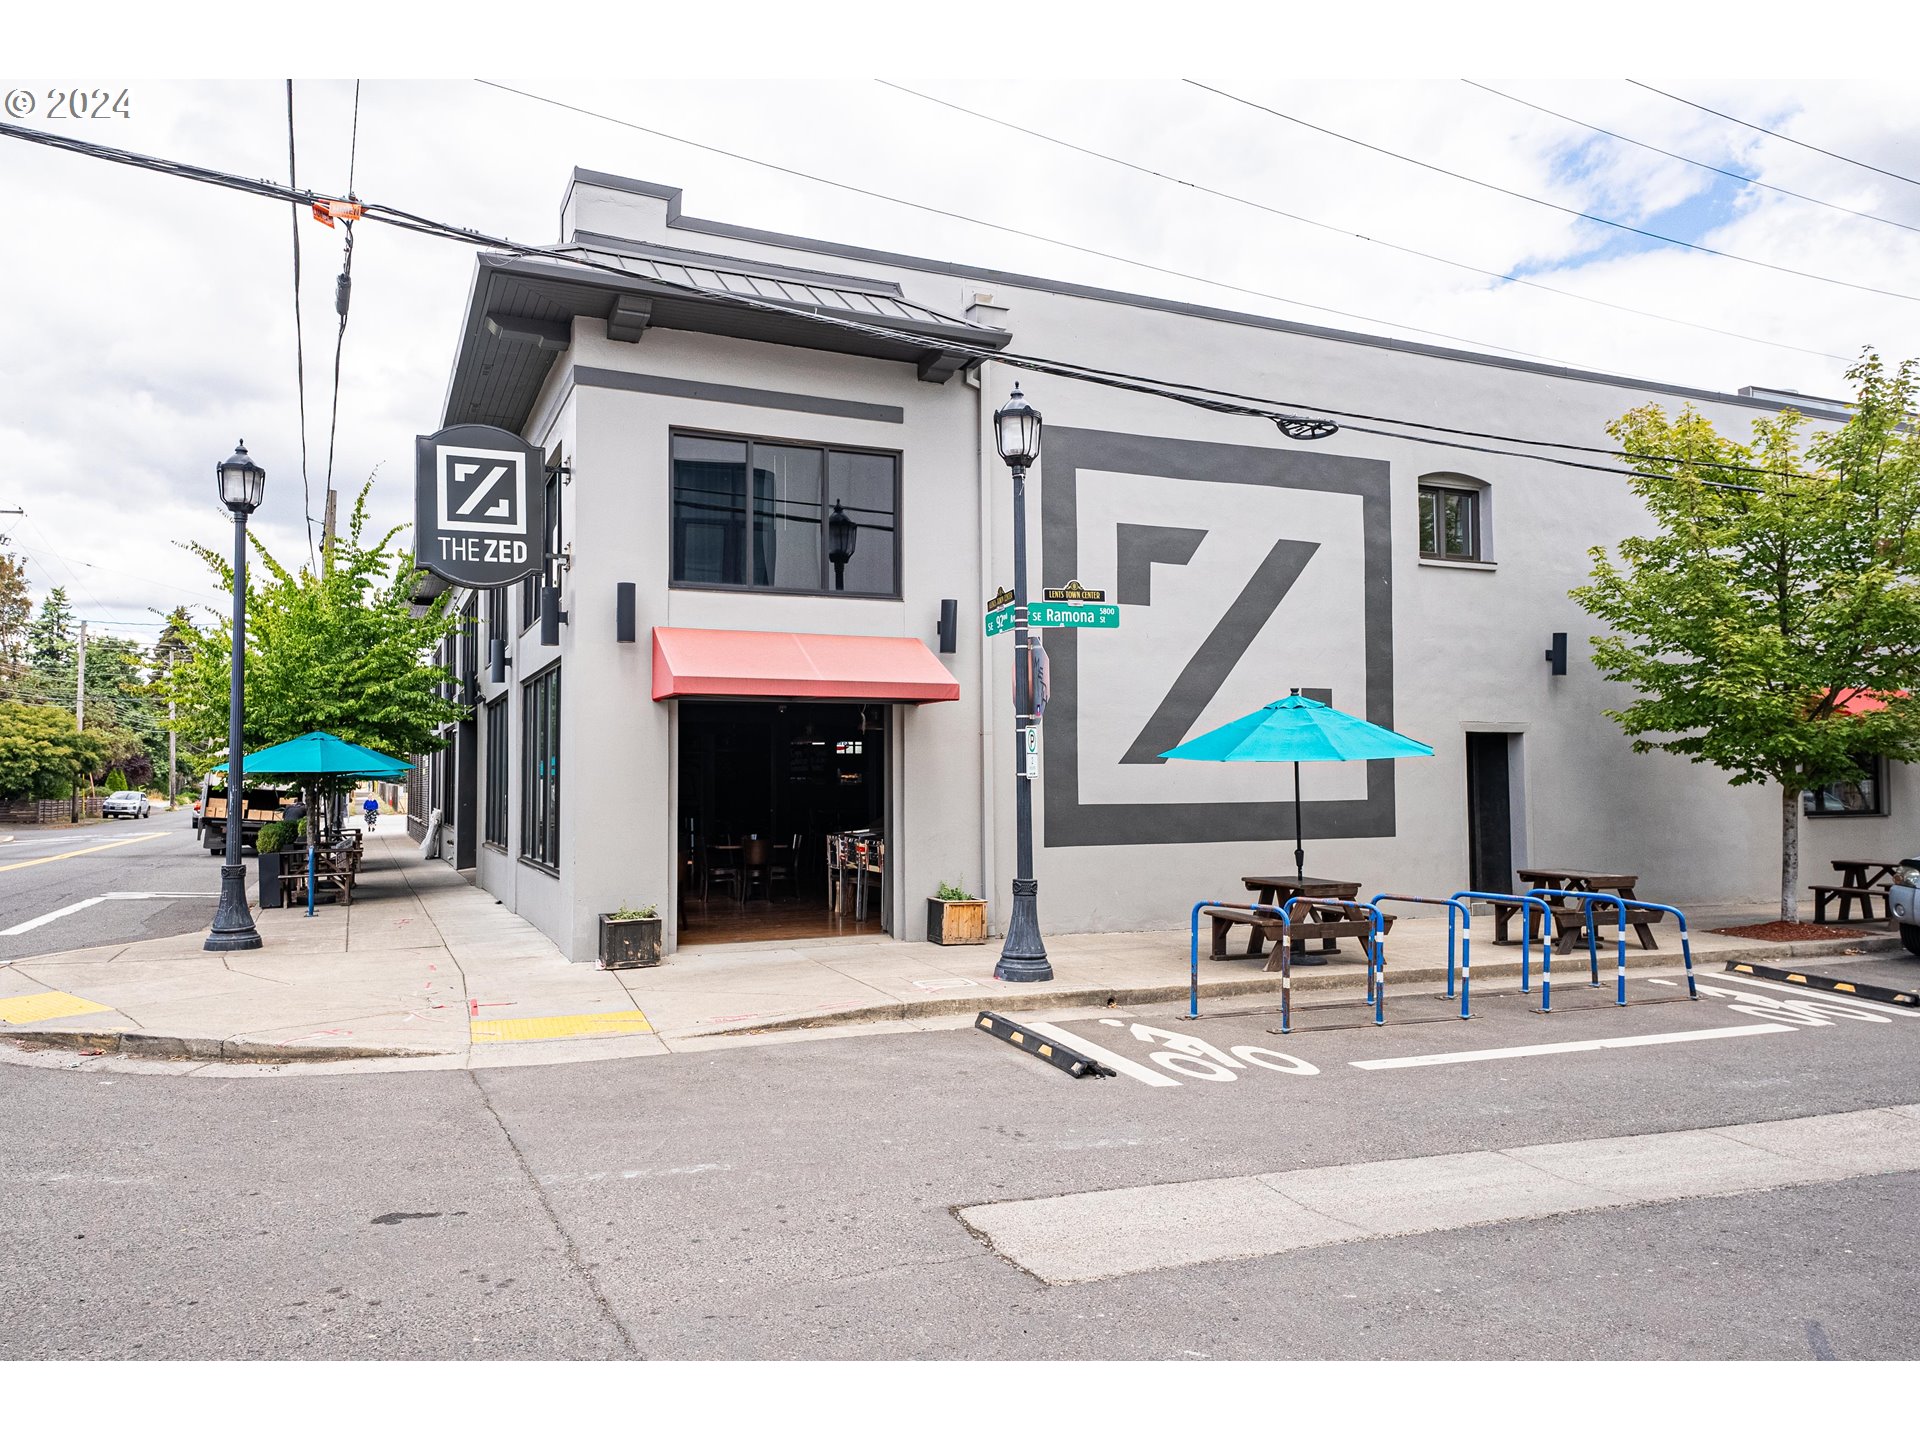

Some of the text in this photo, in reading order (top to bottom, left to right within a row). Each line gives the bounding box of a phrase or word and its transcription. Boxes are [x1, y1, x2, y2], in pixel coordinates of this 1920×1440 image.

[437, 536, 528, 564] THE ZED
[1048, 590, 1101, 600] LENTS TOWN CENTER
[1032, 608, 1106, 624] SE Ramona St
[1099, 607, 1115, 616] 5800
[988, 621, 994, 631] SE
